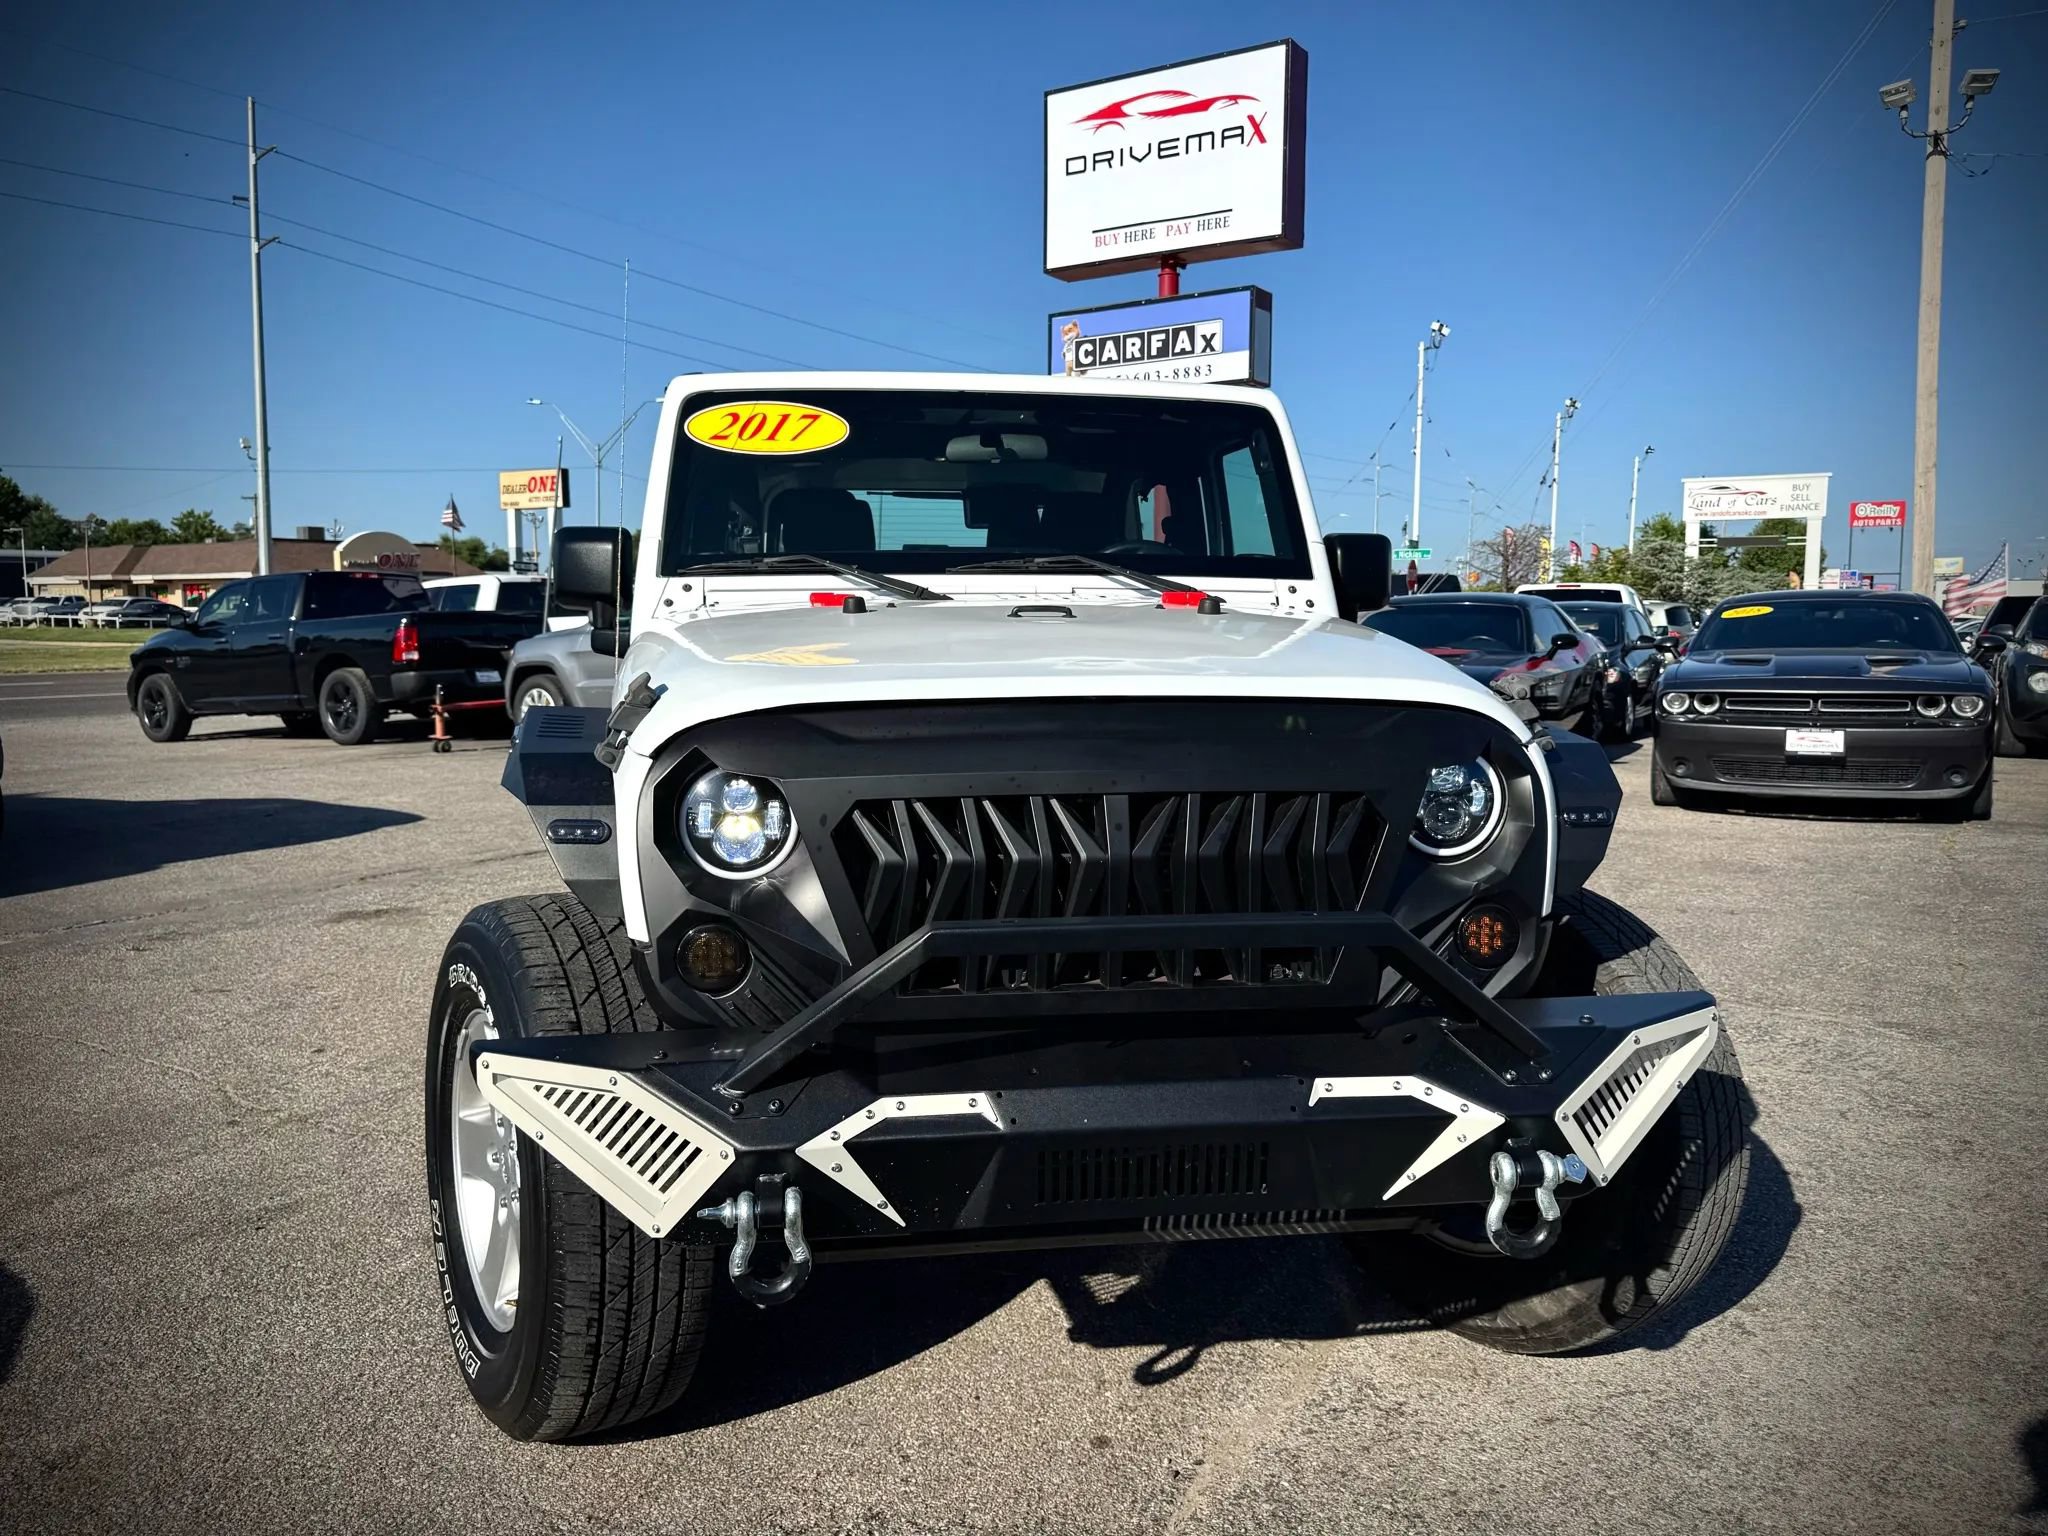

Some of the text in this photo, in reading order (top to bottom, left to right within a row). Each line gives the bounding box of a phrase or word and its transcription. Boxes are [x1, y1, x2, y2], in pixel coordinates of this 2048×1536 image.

[1066, 111, 1267, 176] DRIVEMAX
[1095, 216, 1231, 248] BUY HERE PAY HERE
[1077, 328, 1218, 366] CARFAX
[708, 412, 822, 441] 2017
[502, 475, 557, 495] DEALER ONE
[1792, 483, 1811, 491] BUY
[1689, 495, 1721, 510] Land
[1744, 493, 1777, 506] Cars
[1791, 493, 1811, 501] SELL
[1780, 502, 1821, 512] FINANCE
[1875, 518, 1902, 526] PARTS
